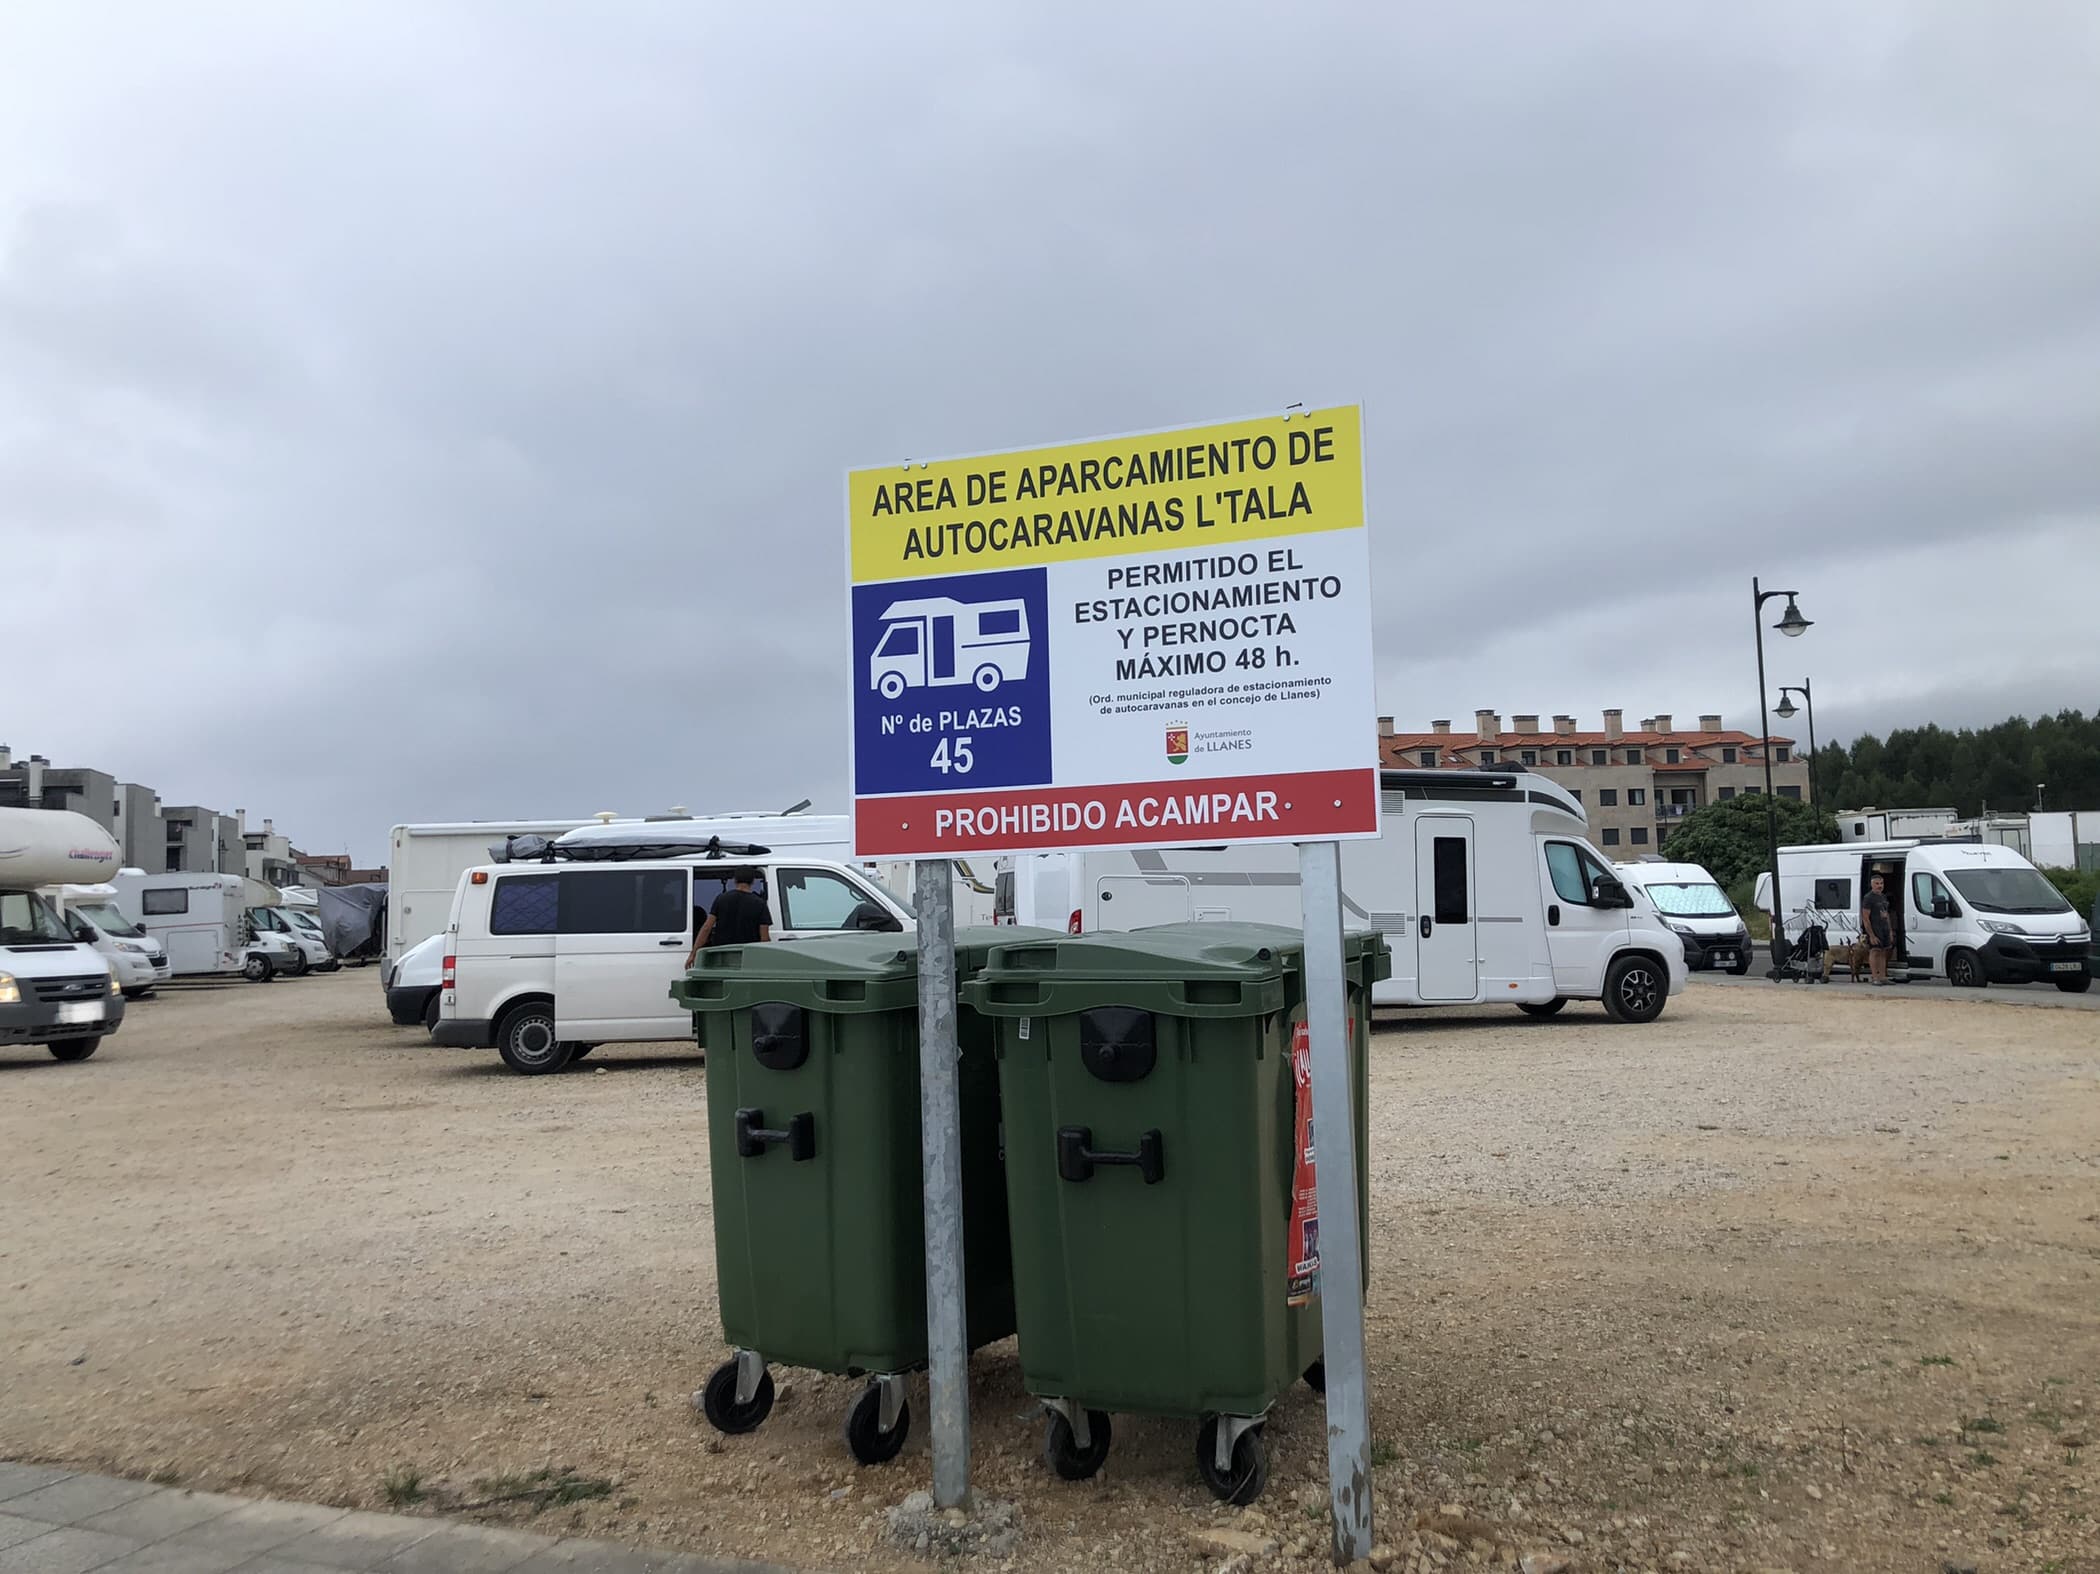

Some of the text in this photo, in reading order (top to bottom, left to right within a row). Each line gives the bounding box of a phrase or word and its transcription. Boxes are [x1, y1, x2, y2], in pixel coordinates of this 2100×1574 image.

[872, 426, 1335, 517] AREA DE APARCAMIENTO DE
[903, 481, 1313, 561] AUTOCARAVANAS L'TALA
[1108, 548, 1304, 590] PERMITIDO EL
[1075, 575, 1342, 624] ESTACIONAMIENTO
[1116, 612, 1297, 650] Y PERNOCTA
[1116, 644, 1300, 681] MÁXIMO 48 h.
[1089, 677, 1332, 706] (Ord. municipal reguladora de estacionamiento
[1100, 688, 1321, 714] de autocaravanas en el concejo de Llanes)
[881, 705, 1022, 735] Nº de PLAZAS
[1194, 729, 1252, 741] Ayuntamiento
[930, 736, 974, 774] 45
[1194, 739, 1252, 753] de LLANES
[935, 790, 1280, 838] PROHIBIDO ACAMPAR
